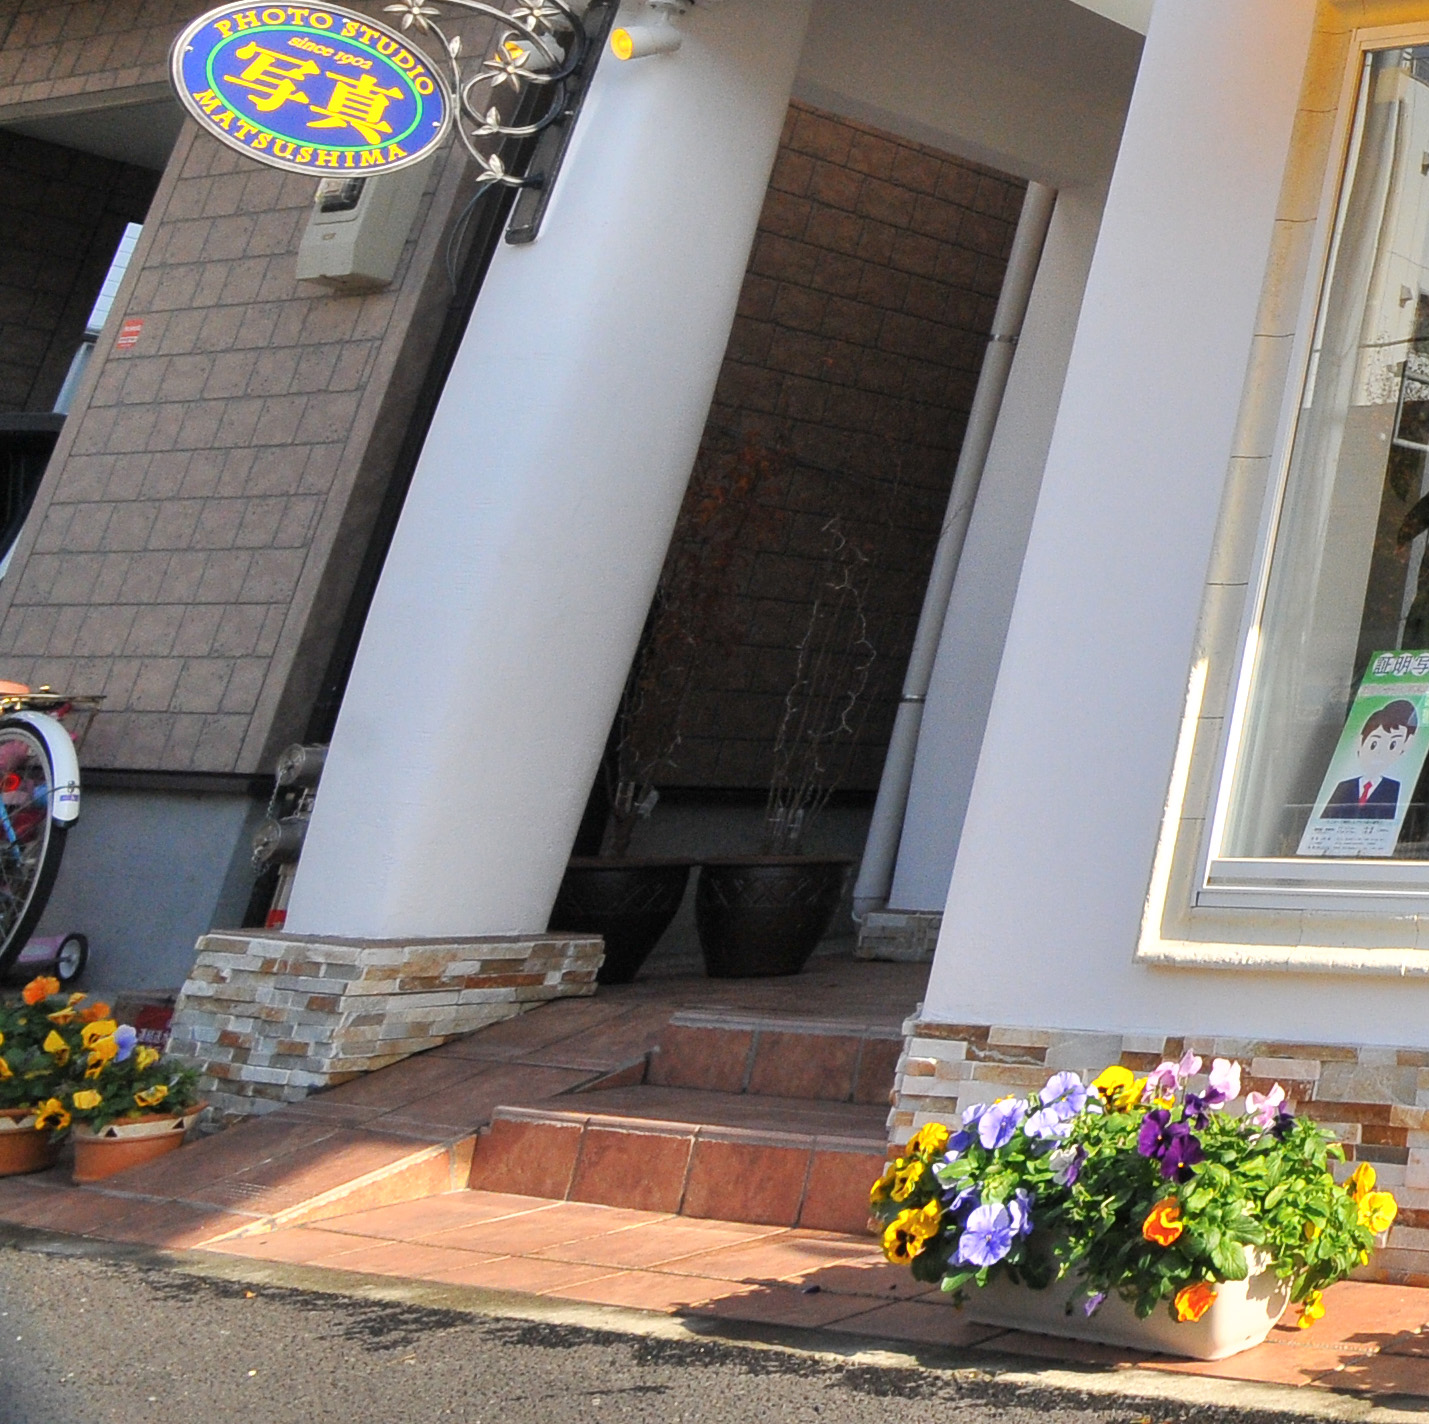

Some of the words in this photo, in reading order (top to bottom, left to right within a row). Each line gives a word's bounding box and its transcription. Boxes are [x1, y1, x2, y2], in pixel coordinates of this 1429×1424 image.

[213, 6, 334, 39] PHOTO
[341, 21, 435, 96] STUDIO
[224, 41, 405, 145] 写真
[287, 36, 335, 57] since
[333, 51, 374, 70] 1902
[193, 88, 408, 168] MATSUSHIMA
